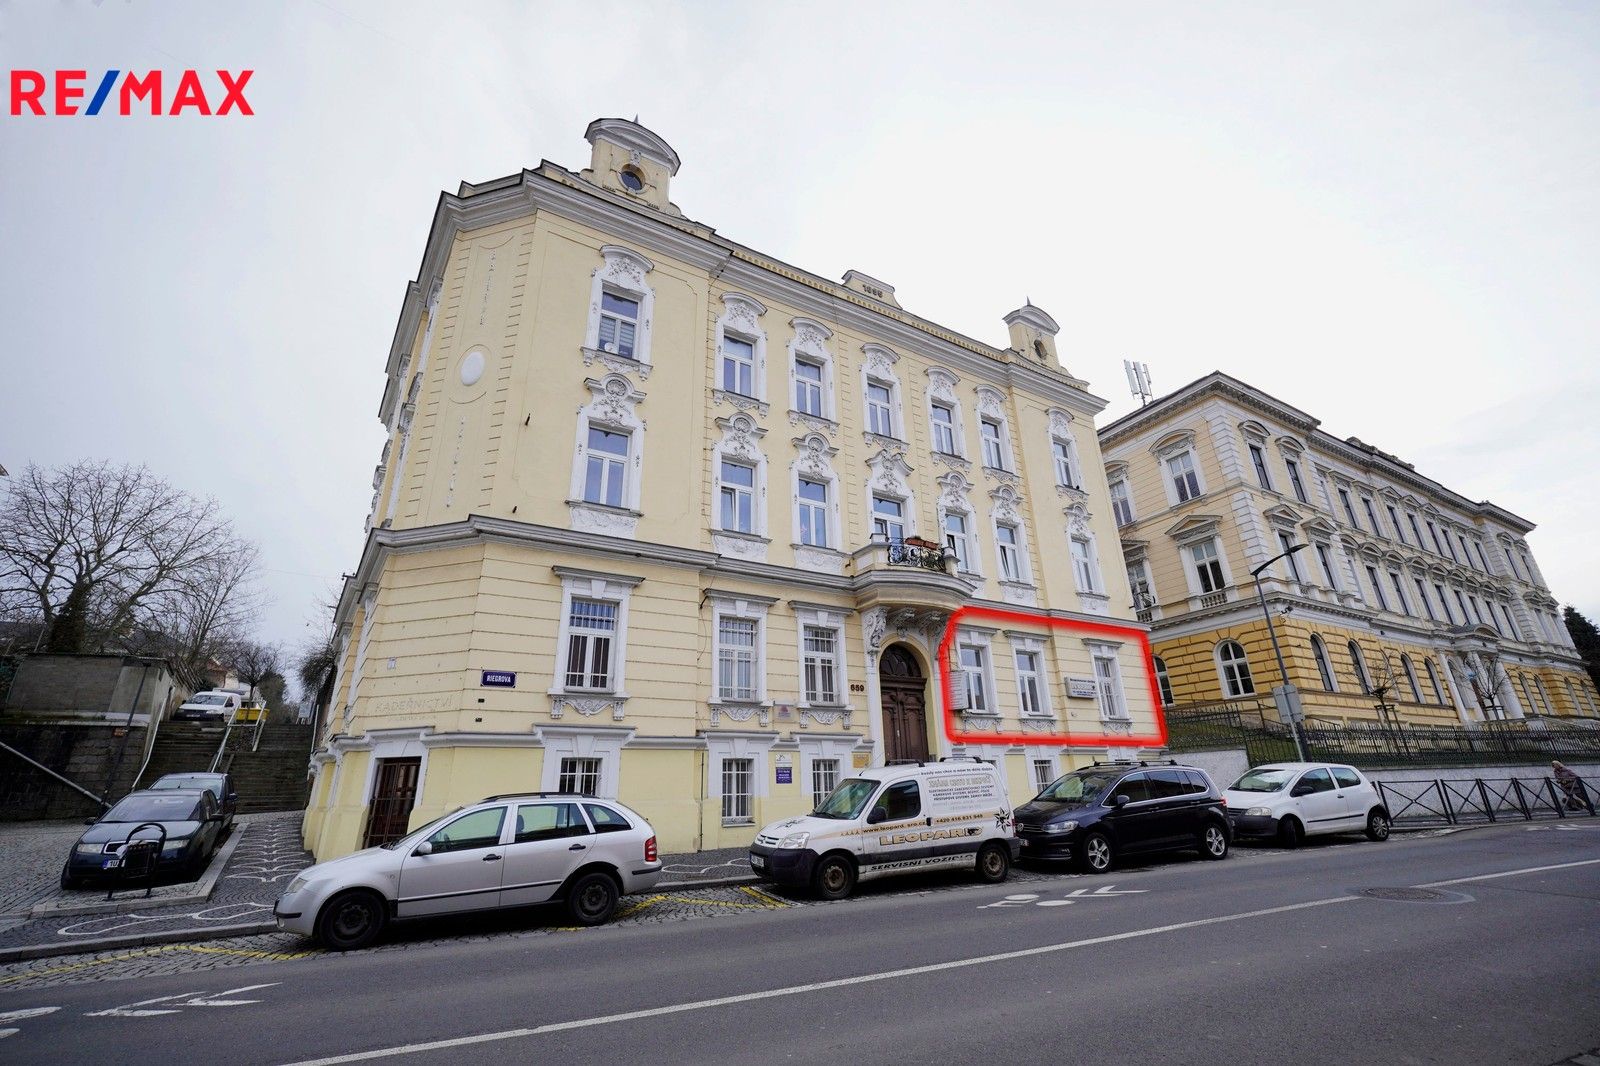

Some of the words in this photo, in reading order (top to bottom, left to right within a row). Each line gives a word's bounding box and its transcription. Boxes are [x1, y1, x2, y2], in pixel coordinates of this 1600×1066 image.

[486, 674, 511, 682] RIEGROVA
[879, 827, 983, 846] LEOPARD
[870, 860, 921, 871] SERVISNÍ
[925, 854, 974, 864] VOZIDLO
